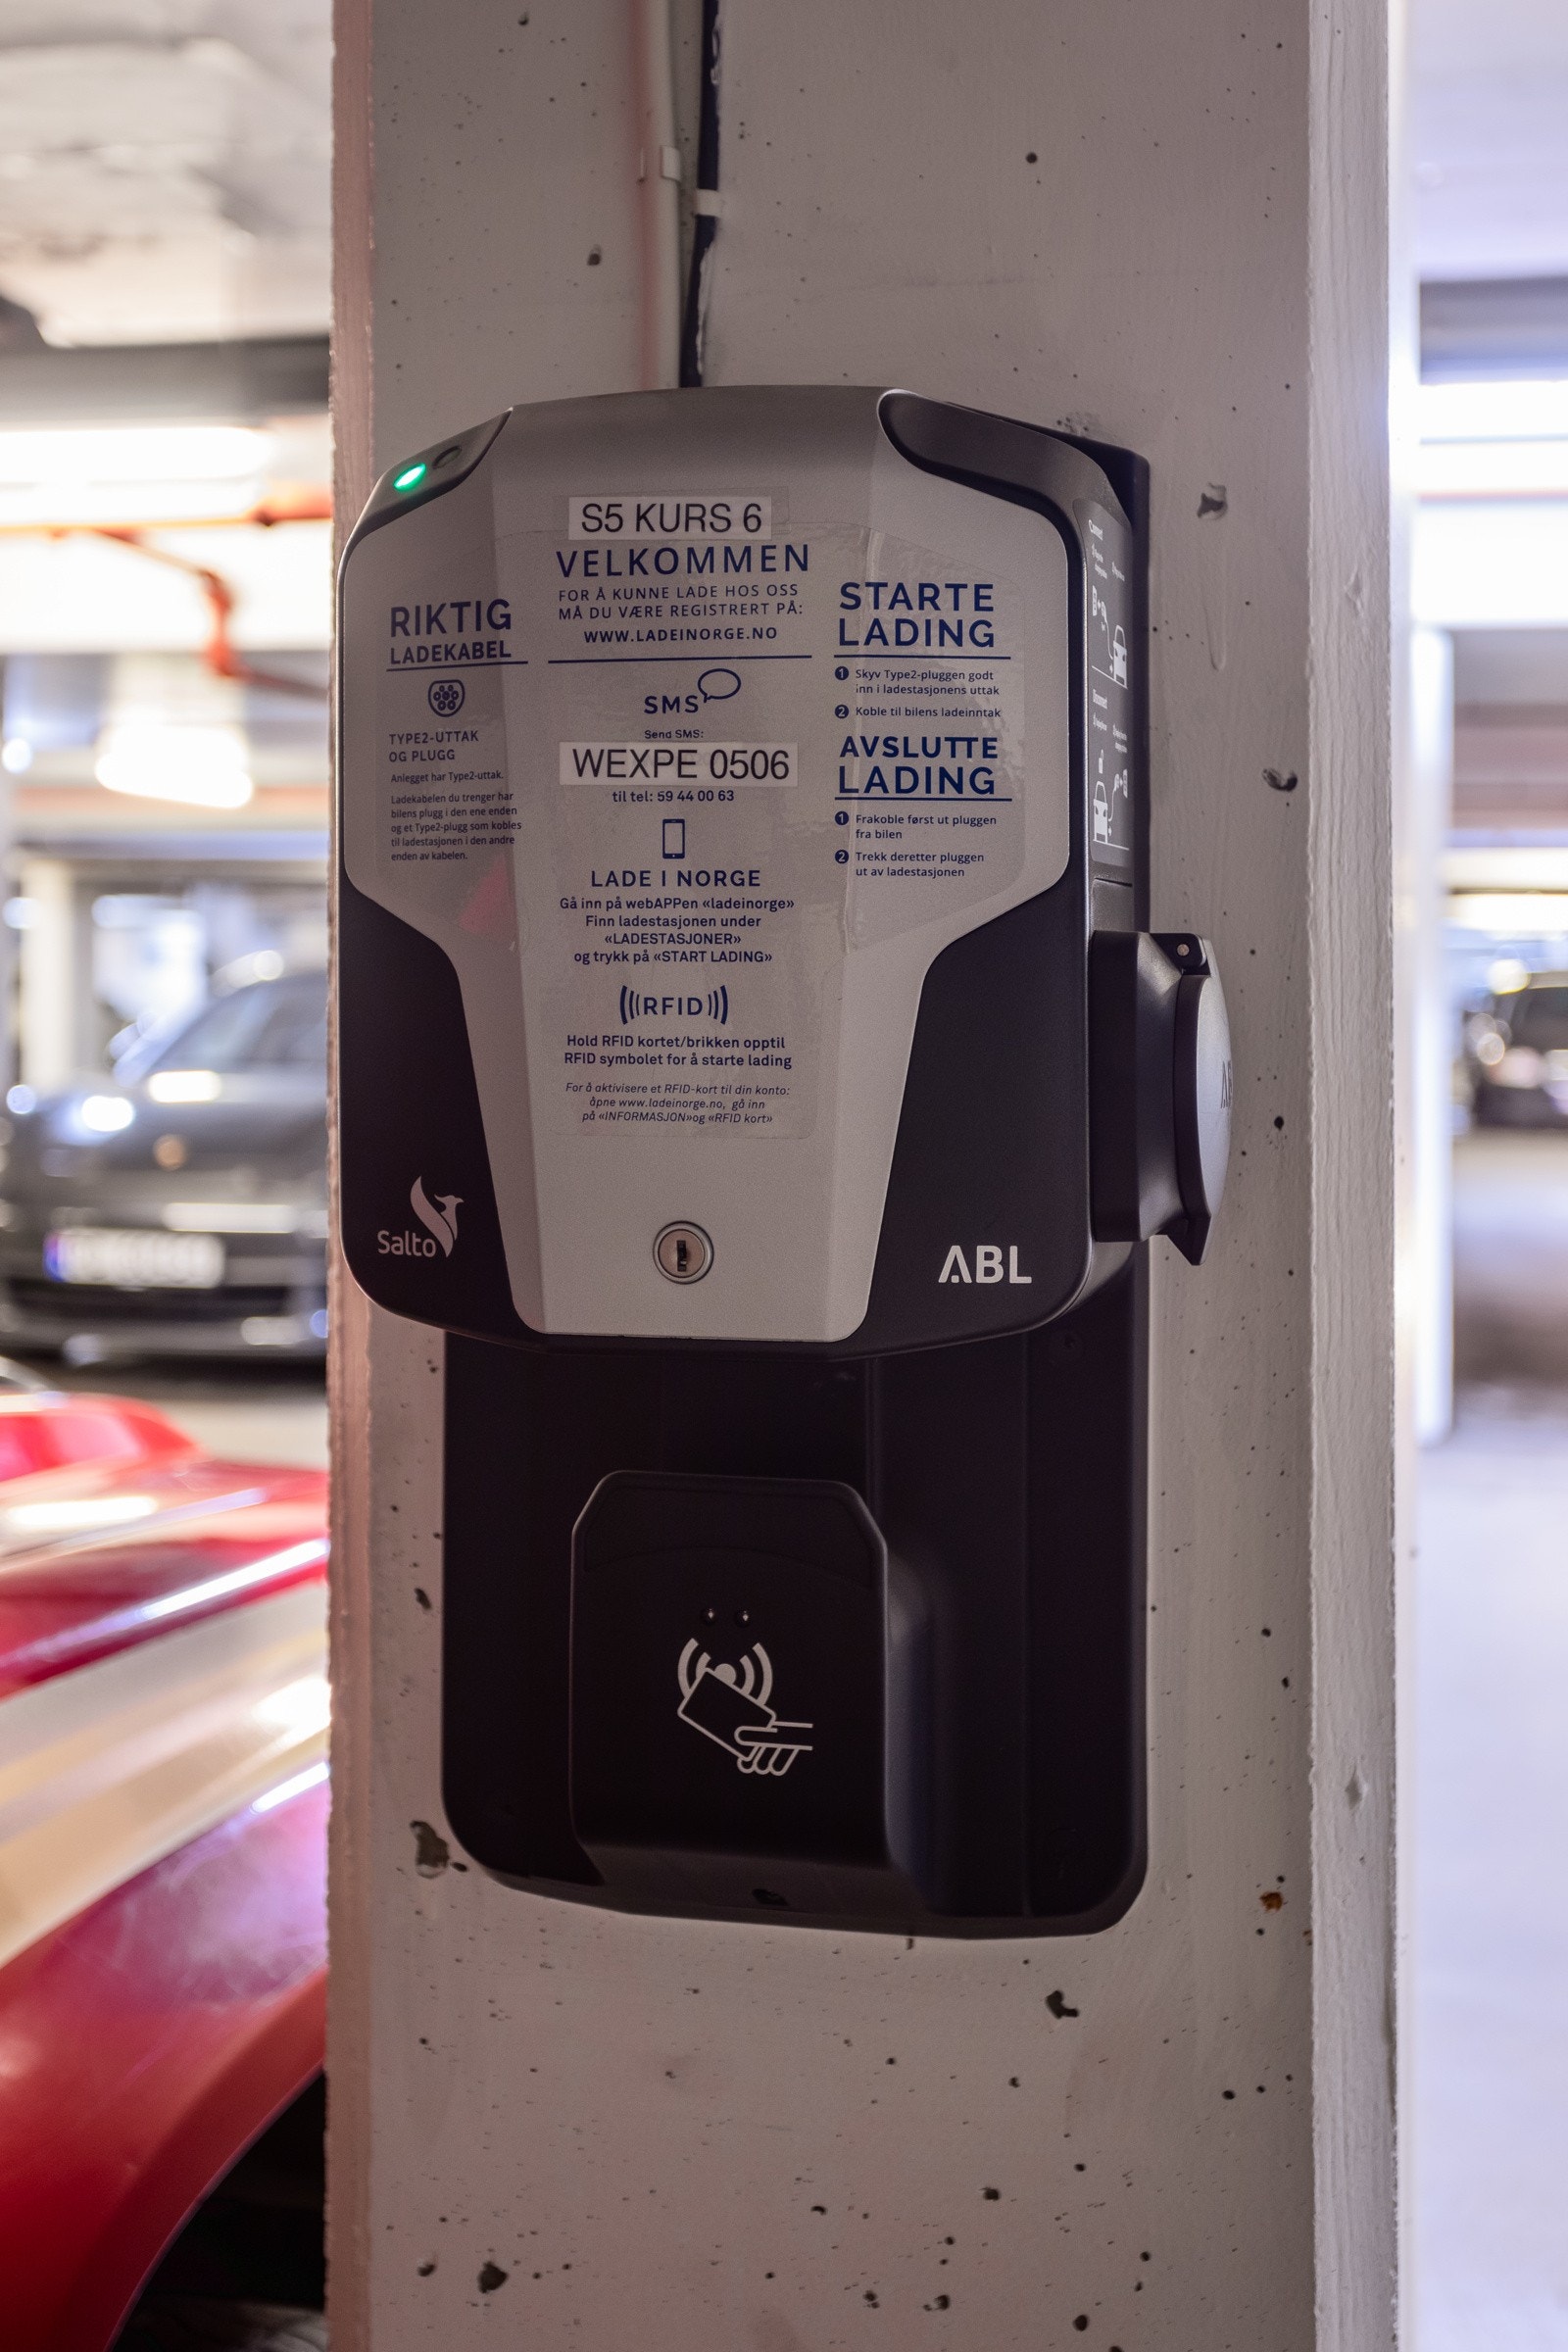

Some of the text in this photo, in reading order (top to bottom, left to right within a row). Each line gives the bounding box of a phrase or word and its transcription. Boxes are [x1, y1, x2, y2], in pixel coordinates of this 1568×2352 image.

[581, 503, 762, 533] S5 KURS 6
[556, 544, 808, 578] VELKOMMEN
[559, 584, 798, 602] FOR Å KUNNE LADE HOS OSS
[839, 581, 994, 612] STARTE
[391, 598, 512, 638] RIKTIG
[559, 600, 803, 620] MÅ DU VÆRE REGISTRERT PÅ:
[584, 626, 777, 644] WWW.LADEINORGE.NO
[839, 617, 995, 648] LADING
[390, 640, 512, 664] LADEKABEL
[856, 668, 881, 680] Skyv
[883, 669, 965, 682] Type2-pluggen
[968, 670, 994, 683] godt
[856, 684, 873, 694] inn
[883, 684, 967, 696] ladestasjonens
[969, 685, 1000, 696] uttak
[644, 695, 700, 714] SMS
[856, 707, 887, 716] Koble
[891, 707, 902, 716] til
[905, 707, 938, 717] bilens
[941, 707, 1002, 718] ladeinntak
[389, 730, 479, 746] TYPE2-UTTAK
[644, 729, 704, 739] Send SMS:
[389, 749, 456, 762] OG PLUGG
[839, 736, 998, 760] AVSLUTTE
[572, 749, 790, 780] WEXPE 0506
[391, 770, 504, 784] Anlegget har Type2-uttak.
[839, 765, 995, 795] LADING
[391, 791, 514, 805] Ladekabelen du trenger har
[612, 790, 735, 803] til tel: 59 44 00 63
[391, 808, 417, 819] bilens
[418, 808, 443, 820] plugg
[450, 807, 466, 817] den
[488, 806, 517, 815] enden
[856, 813, 905, 824] Frakoble
[907, 814, 934, 825] først
[937, 815, 949, 825] ut
[953, 814, 997, 827] pluggen
[391, 820, 522, 835] og et Type2-plugg som kobles
[856, 829, 903, 839] fra bilen
[391, 837, 401, 847] til
[402, 835, 463, 849] ladestasjonen
[470, 835, 487, 845] den
[489, 834, 514, 845] andre
[391, 851, 417, 860] enden
[431, 851, 467, 860] kabelen.
[856, 852, 887, 861] Trekk
[890, 852, 936, 862] deretter
[940, 853, 984, 864] pluggen
[591, 869, 760, 888] LADE I NORGE
[856, 866, 964, 879] ut av ladestasjonen
[560, 896, 795, 912] Gå inn på webAPPen «ladeinorge»
[585, 915, 761, 929] Finn ladestasjonen under
[605, 933, 742, 945] «LADESTASJONER»
[573, 949, 773, 965] og trykk på «START LADING»
[643, 997, 704, 1015] RFID
[566, 1035, 786, 1051] Hold RFID kortet/brikken opptil
[564, 1052, 792, 1070] RFID symbolet for å starte lading
[565, 1081, 790, 1096] For å aktivisere et RFID-kort til din konto:
[589, 1096, 765, 1111] åpne www.ladeinorge.no, gå inn
[582, 1110, 596, 1123] på
[708, 1112, 741, 1124] «RFID
[744, 1113, 773, 1124] kort»
[377, 1230, 437, 1258] Salto
[938, 1245, 1033, 1284] ABL
